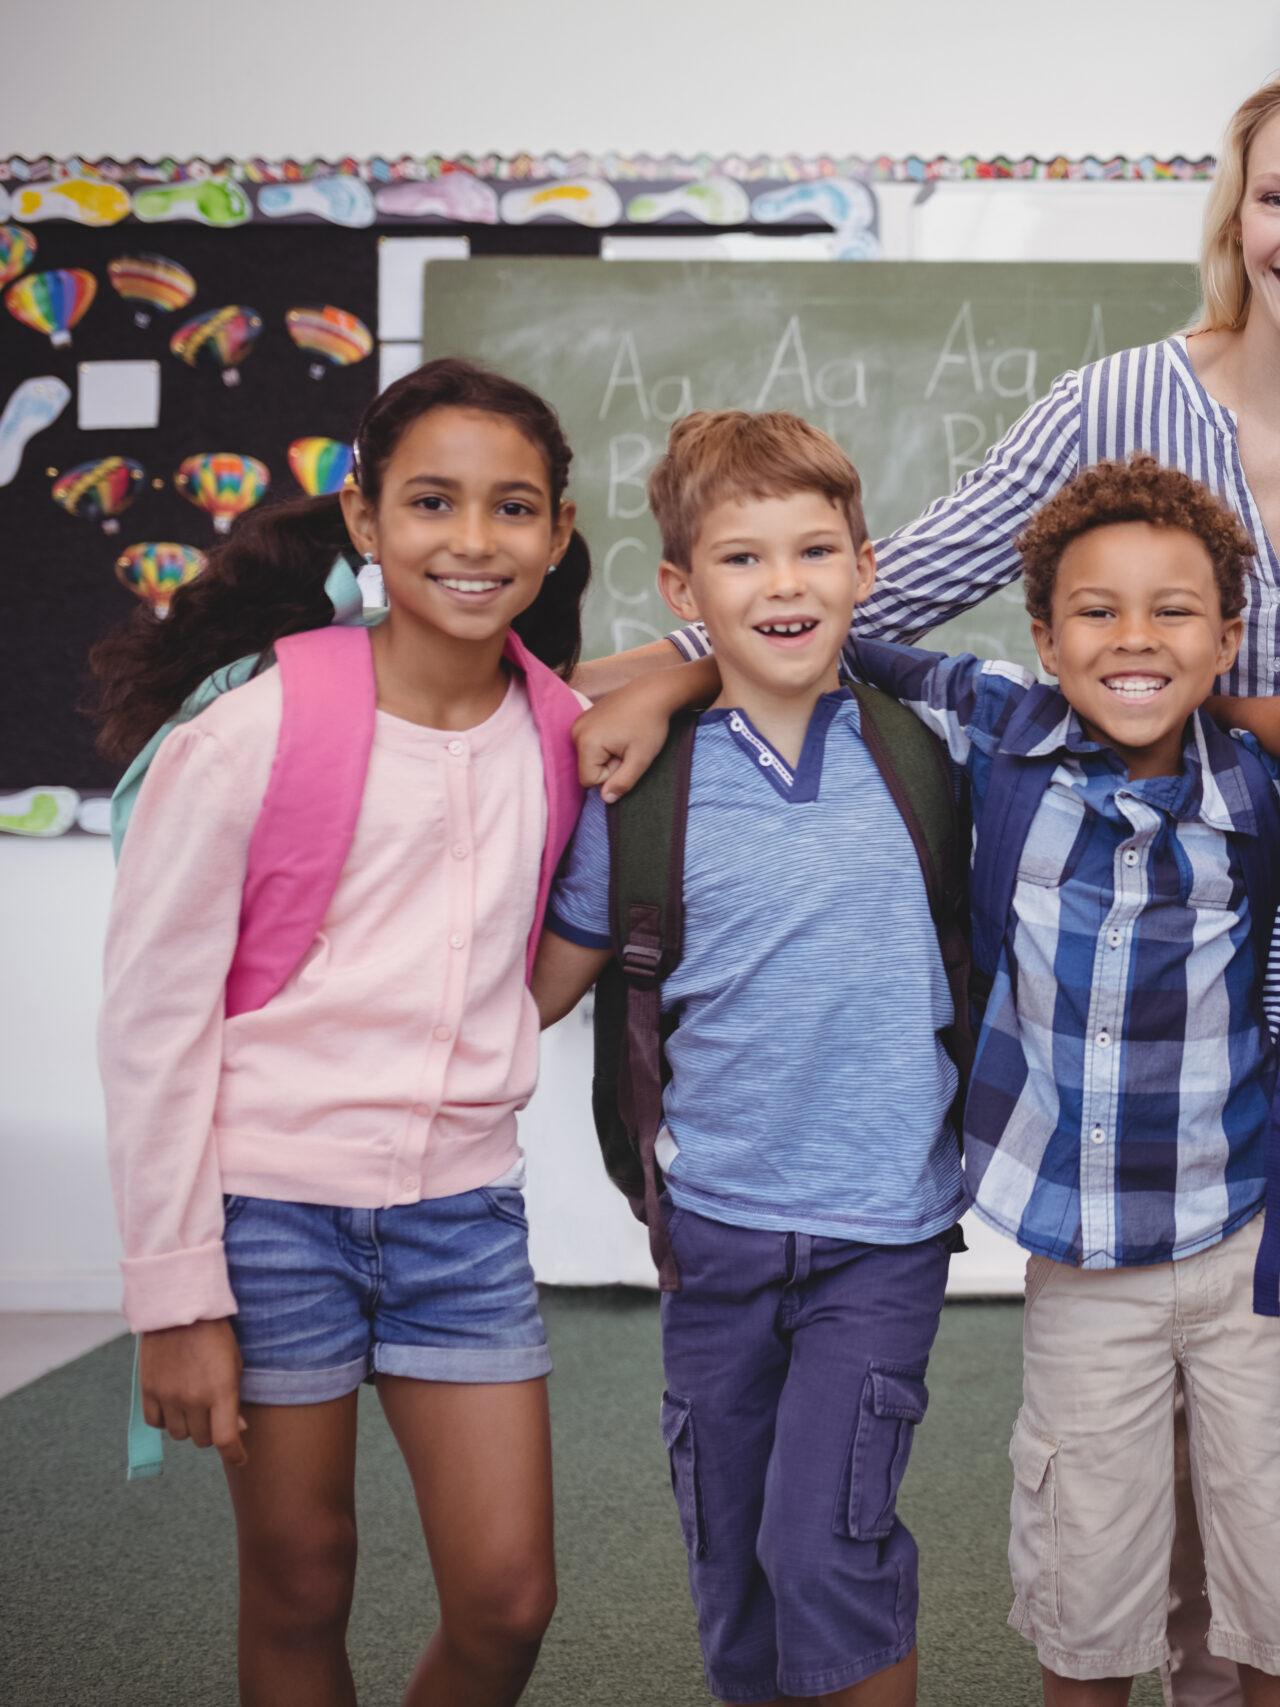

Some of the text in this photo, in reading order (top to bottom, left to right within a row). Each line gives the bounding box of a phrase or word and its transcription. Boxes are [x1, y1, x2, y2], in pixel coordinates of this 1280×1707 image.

[598, 330, 694, 422] Aa
[753, 314, 867, 409] Aa
[924, 300, 1038, 403] Aa
